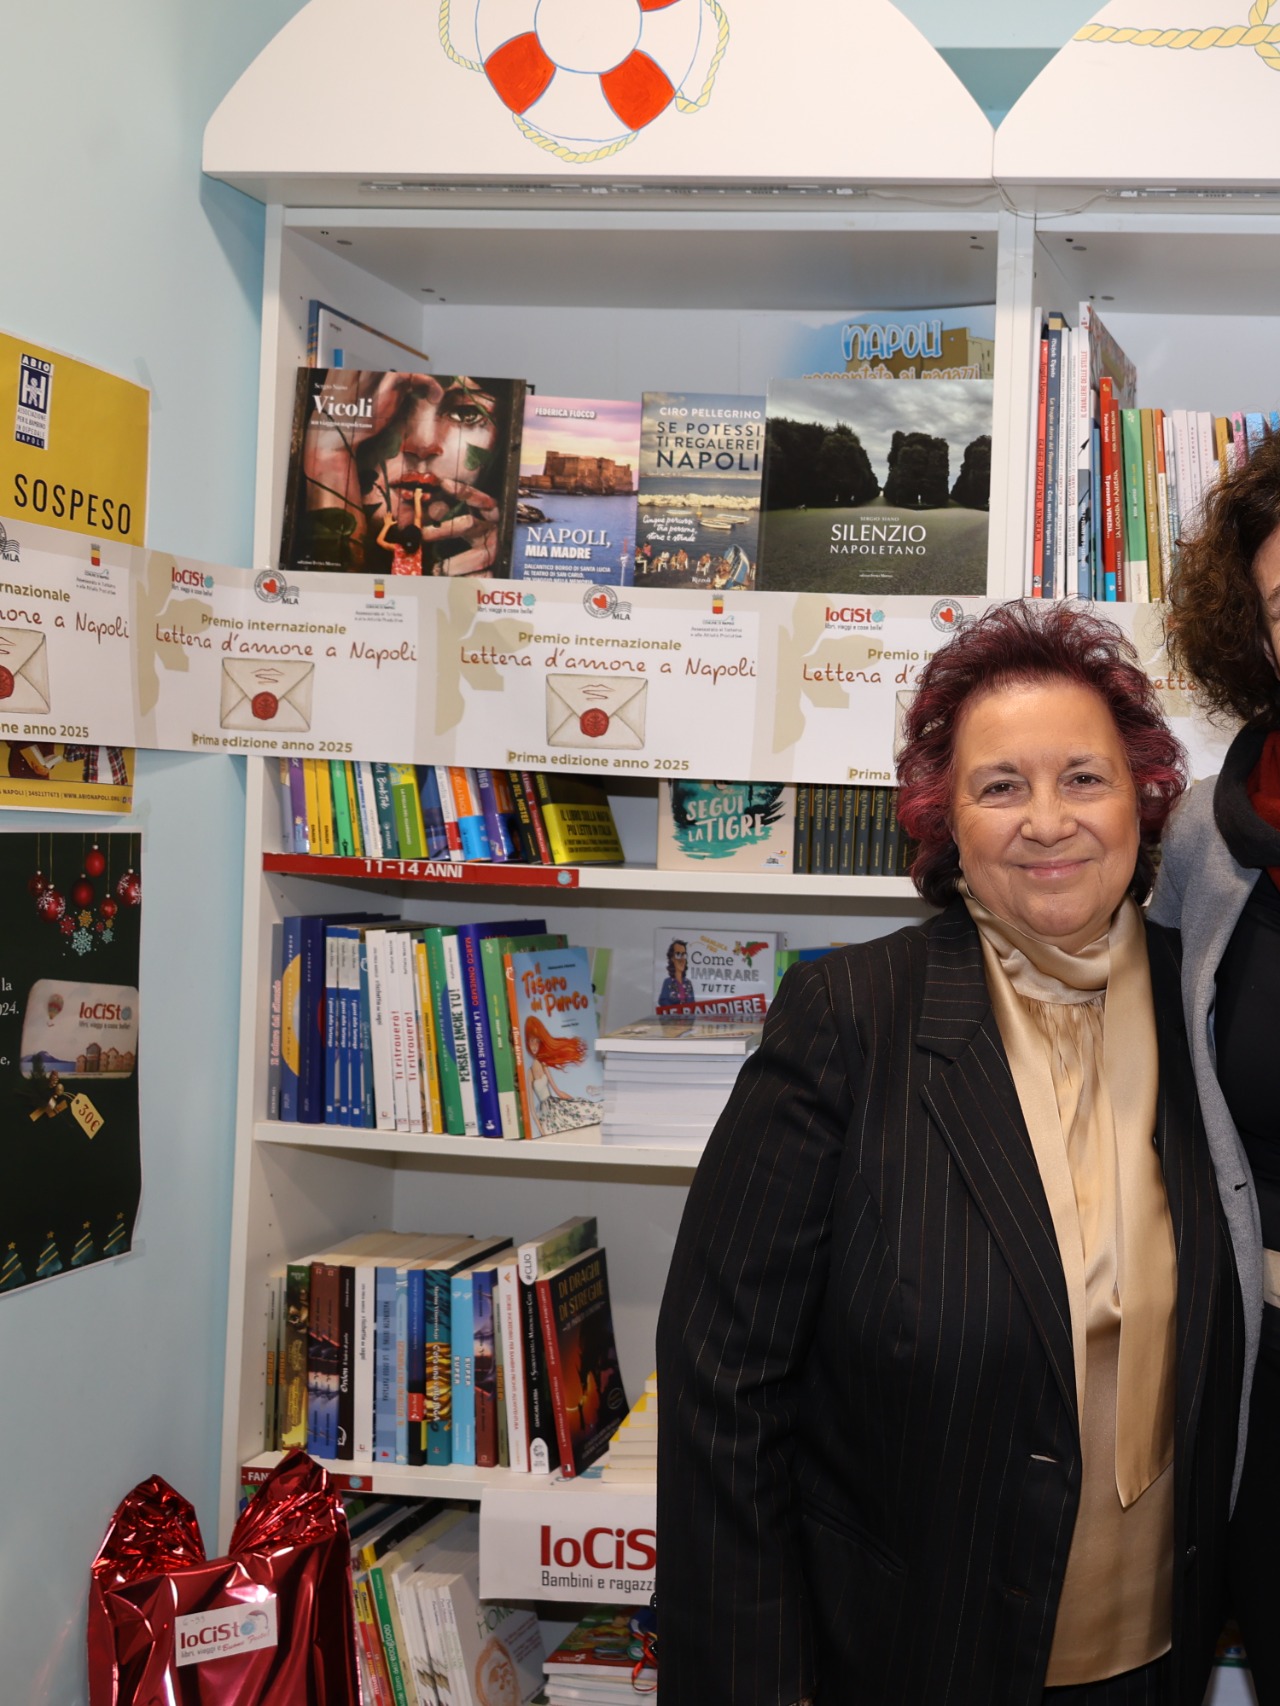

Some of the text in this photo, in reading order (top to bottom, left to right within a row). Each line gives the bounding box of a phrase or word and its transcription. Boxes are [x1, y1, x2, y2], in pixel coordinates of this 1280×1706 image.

[22, 355, 51, 372] ABIO
[313, 394, 373, 418] Vicoli
[535, 407, 596, 419] FEDERICA FLOCCO
[659, 407, 761, 420] CIRO PELLEGRINO
[657, 421, 677, 434] SE
[657, 436, 760, 450] TI REGALEREI
[657, 450, 758, 471] NAPOLI
[14, 474, 131, 535] SOSPESO
[527, 527, 612, 548] NAPOLI,
[831, 523, 927, 543] SILENZIO
[2, 553, 20, 562] MLA
[525, 545, 591, 560] MIA MADRE
[830, 544, 927, 556] NAPOLETANO
[54, 611, 130, 644] a Napoli
[201, 613, 347, 635] Premio internazionale
[612, 613, 631, 621] MLA
[156, 623, 418, 669] Lettera d'amore a Napoli
[518, 631, 682, 651] Premio internazionale
[867, 648, 919, 661] Premio
[461, 647, 757, 686] Lettera d'amore a Napoli
[803, 662, 881, 684] Lettera
[24, 724, 57, 736] anno
[60, 725, 90, 738] 2025
[192, 732, 353, 753] Prima edizione anno 2025
[508, 750, 690, 771] Prima edizione anno 2025
[848, 767, 891, 781] Prima
[686, 794, 744, 822] SEGUI
[688, 813, 766, 843] LA TIGRE
[363, 859, 464, 879] 11-14 ANNI
[691, 951, 734, 966] Come
[690, 966, 760, 982] IMPARARE
[701, 983, 736, 993] TUTTE
[464, 937, 488, 1093] MARCO ONNEMBO LA PRIGIONE DI CARTA
[543, 992, 589, 1017] Parco
[452, 1012, 467, 1041] ANCHE
[456, 1044, 471, 1083] PENSACI
[78, 1103, 101, 1132] 30€
[524, 1253, 533, 1281] #CLIO
[567, 1260, 600, 1292] DRAGHI
[540, 1571, 594, 1589] Bambini
[597, 1578, 605, 1589] e
